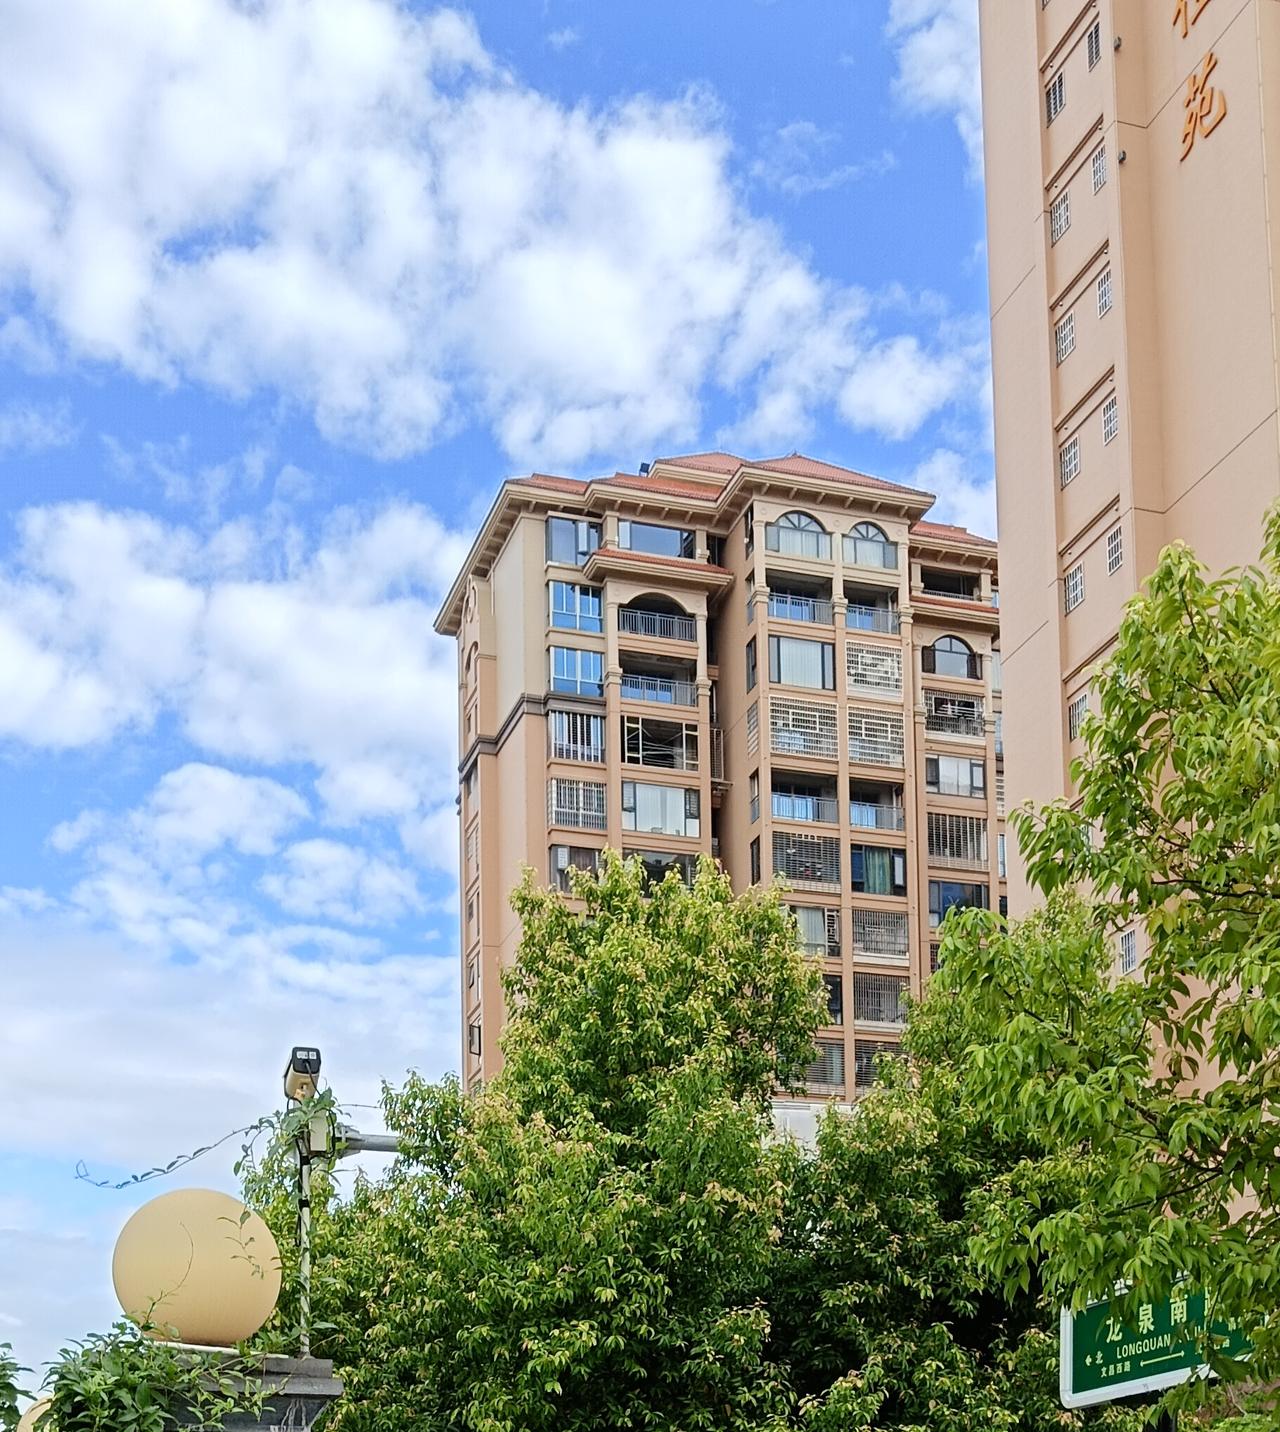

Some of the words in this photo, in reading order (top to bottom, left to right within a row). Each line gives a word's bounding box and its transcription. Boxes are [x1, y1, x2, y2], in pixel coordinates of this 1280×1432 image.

[1106, 1286, 1211, 1343] 龙泉南
[1116, 1333, 1171, 1359] LONGQUAN
[1100, 1360, 1131, 1378] 文昌西路
